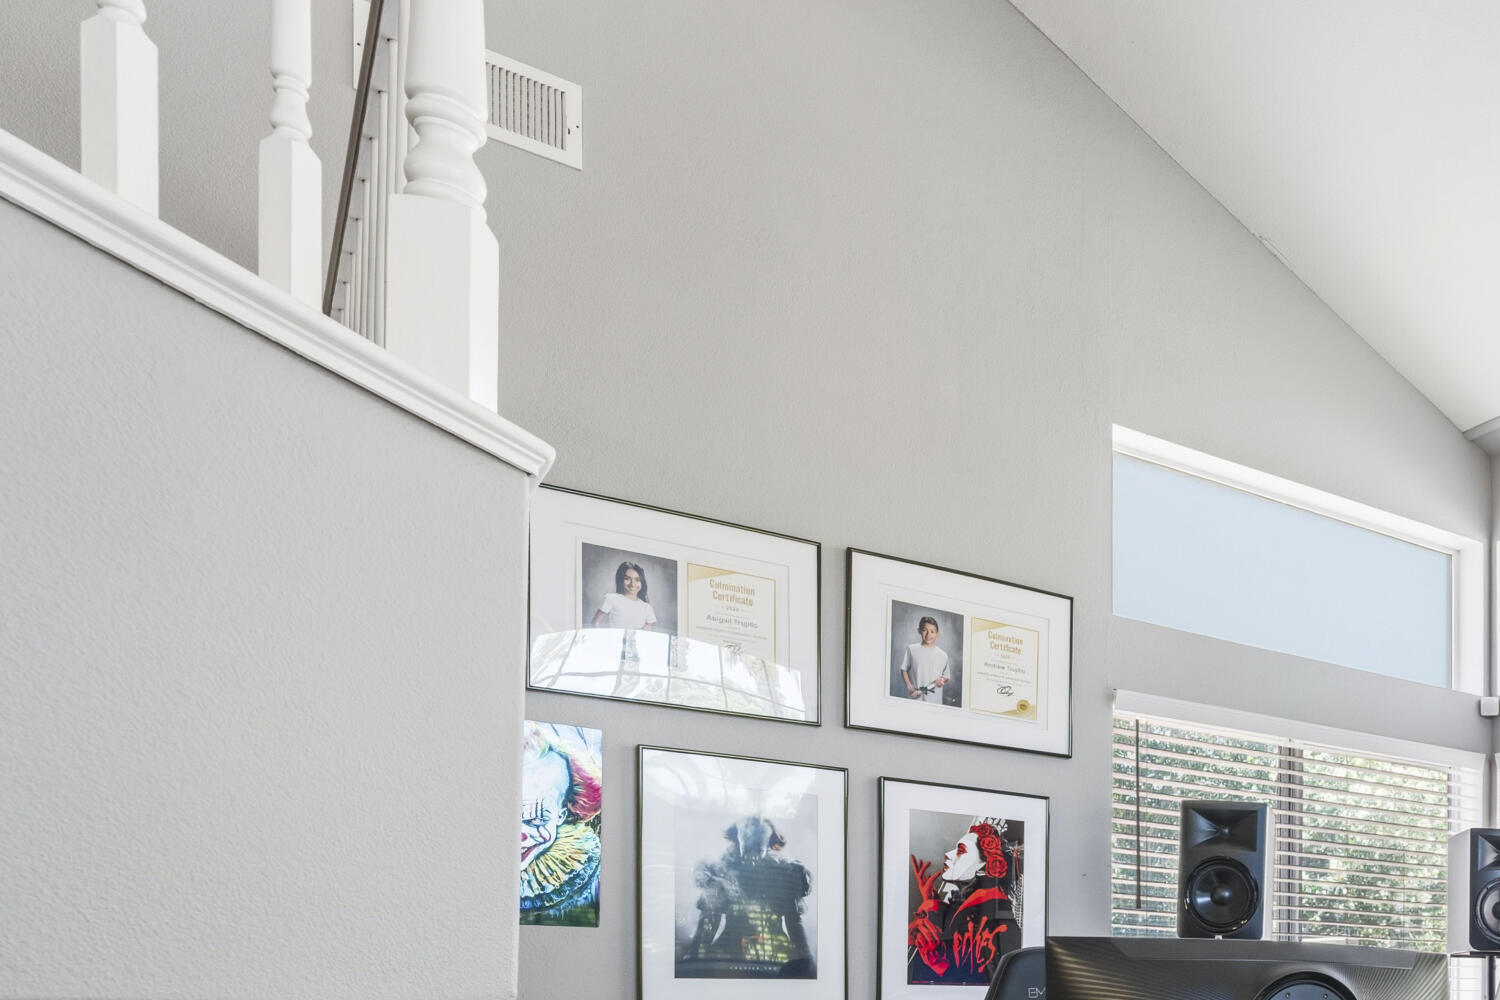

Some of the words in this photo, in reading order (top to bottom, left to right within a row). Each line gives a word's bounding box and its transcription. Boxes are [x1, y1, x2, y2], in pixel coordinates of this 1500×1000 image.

[709, 579, 755, 596] Culmination
[712, 590, 753, 607] Certificate
[988, 631, 1023, 645] Culmination
[990, 641, 1021, 655] Certificate
